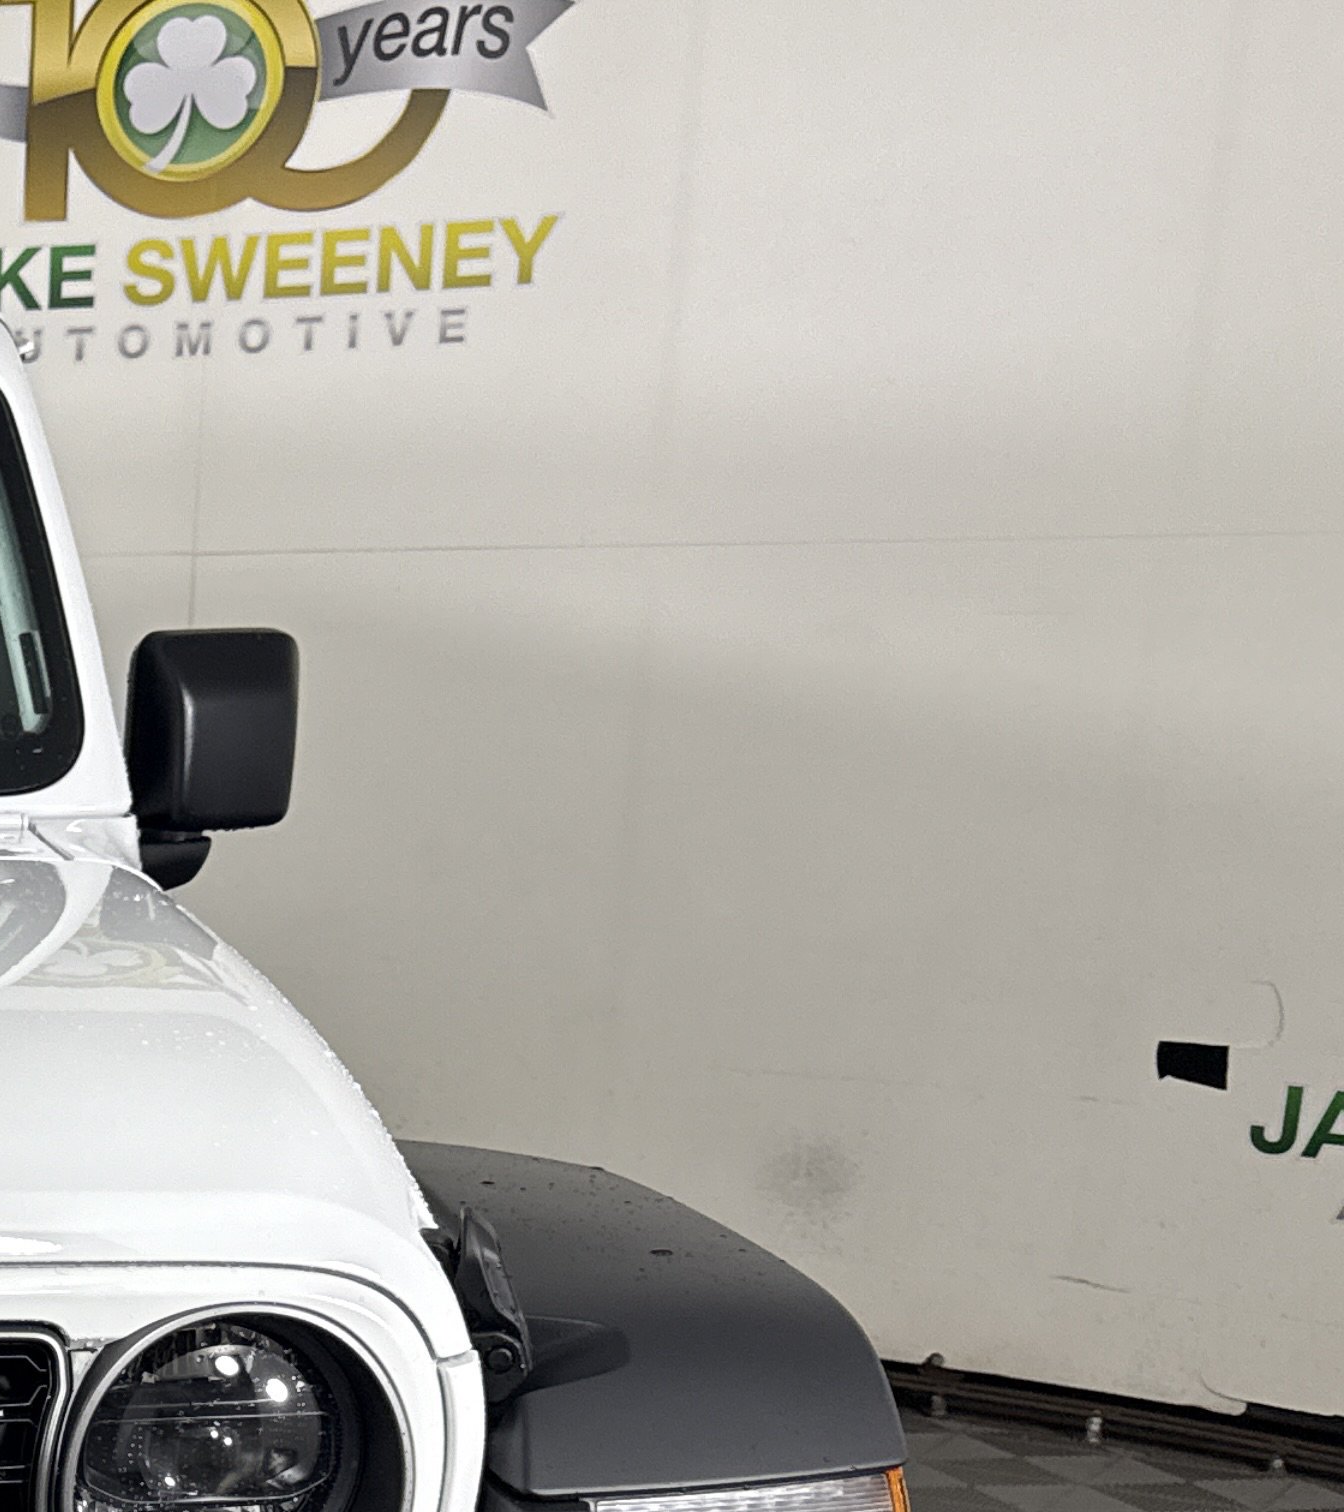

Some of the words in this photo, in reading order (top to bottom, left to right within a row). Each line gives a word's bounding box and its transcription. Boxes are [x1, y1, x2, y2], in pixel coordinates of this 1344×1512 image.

[332, 4, 513, 86] years
[123, 215, 559, 306] SWEENEY
[15, 308, 468, 364] UTOMOTIVE
